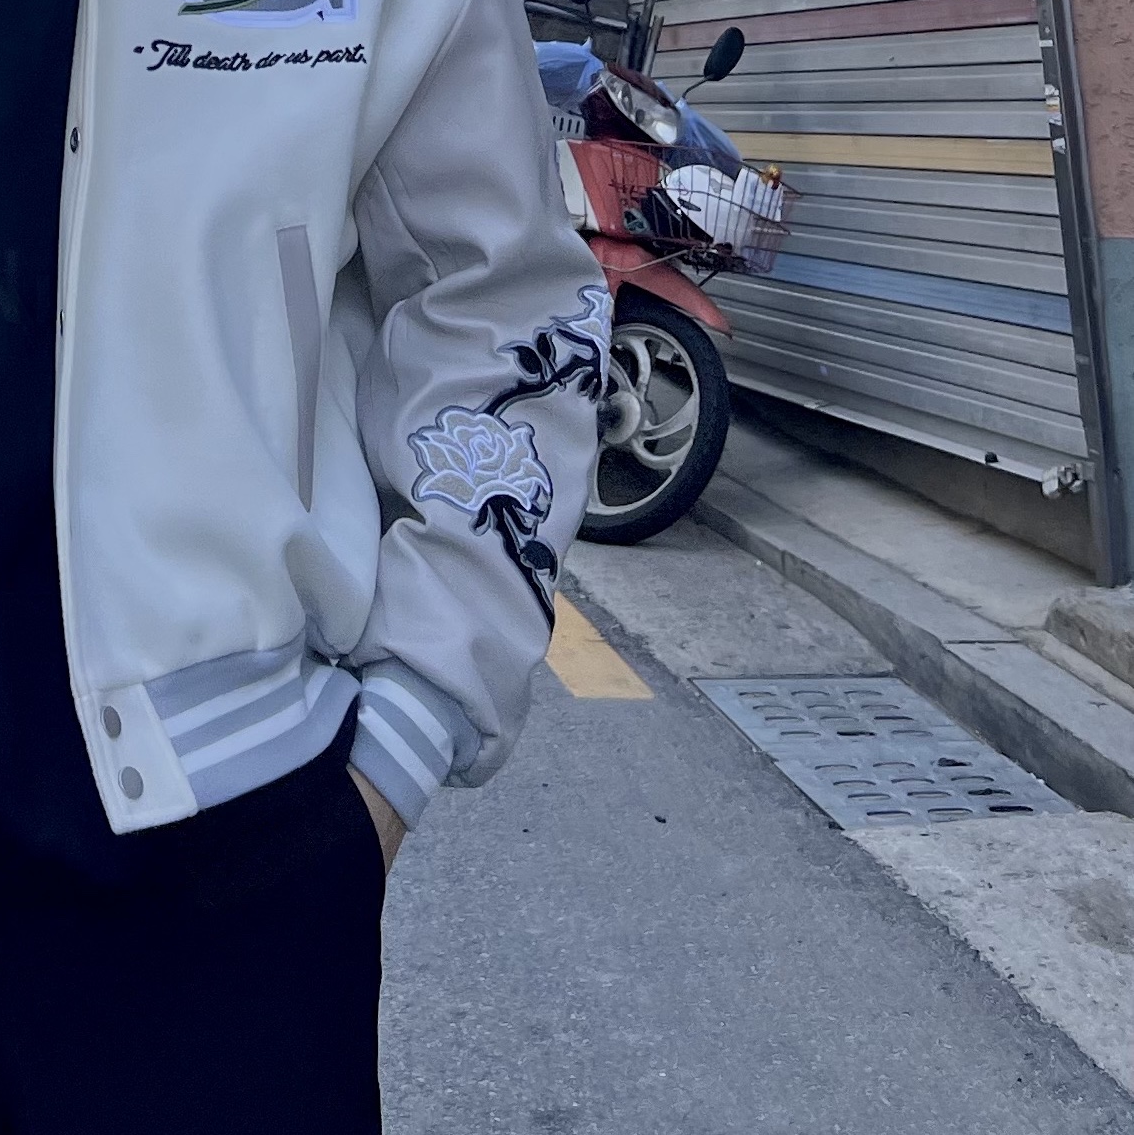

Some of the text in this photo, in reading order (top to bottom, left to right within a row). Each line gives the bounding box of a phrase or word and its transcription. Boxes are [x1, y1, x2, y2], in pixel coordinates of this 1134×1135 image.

[192, 51, 253, 72] death
[254, 51, 286, 70] do
[284, 49, 313, 64] us
